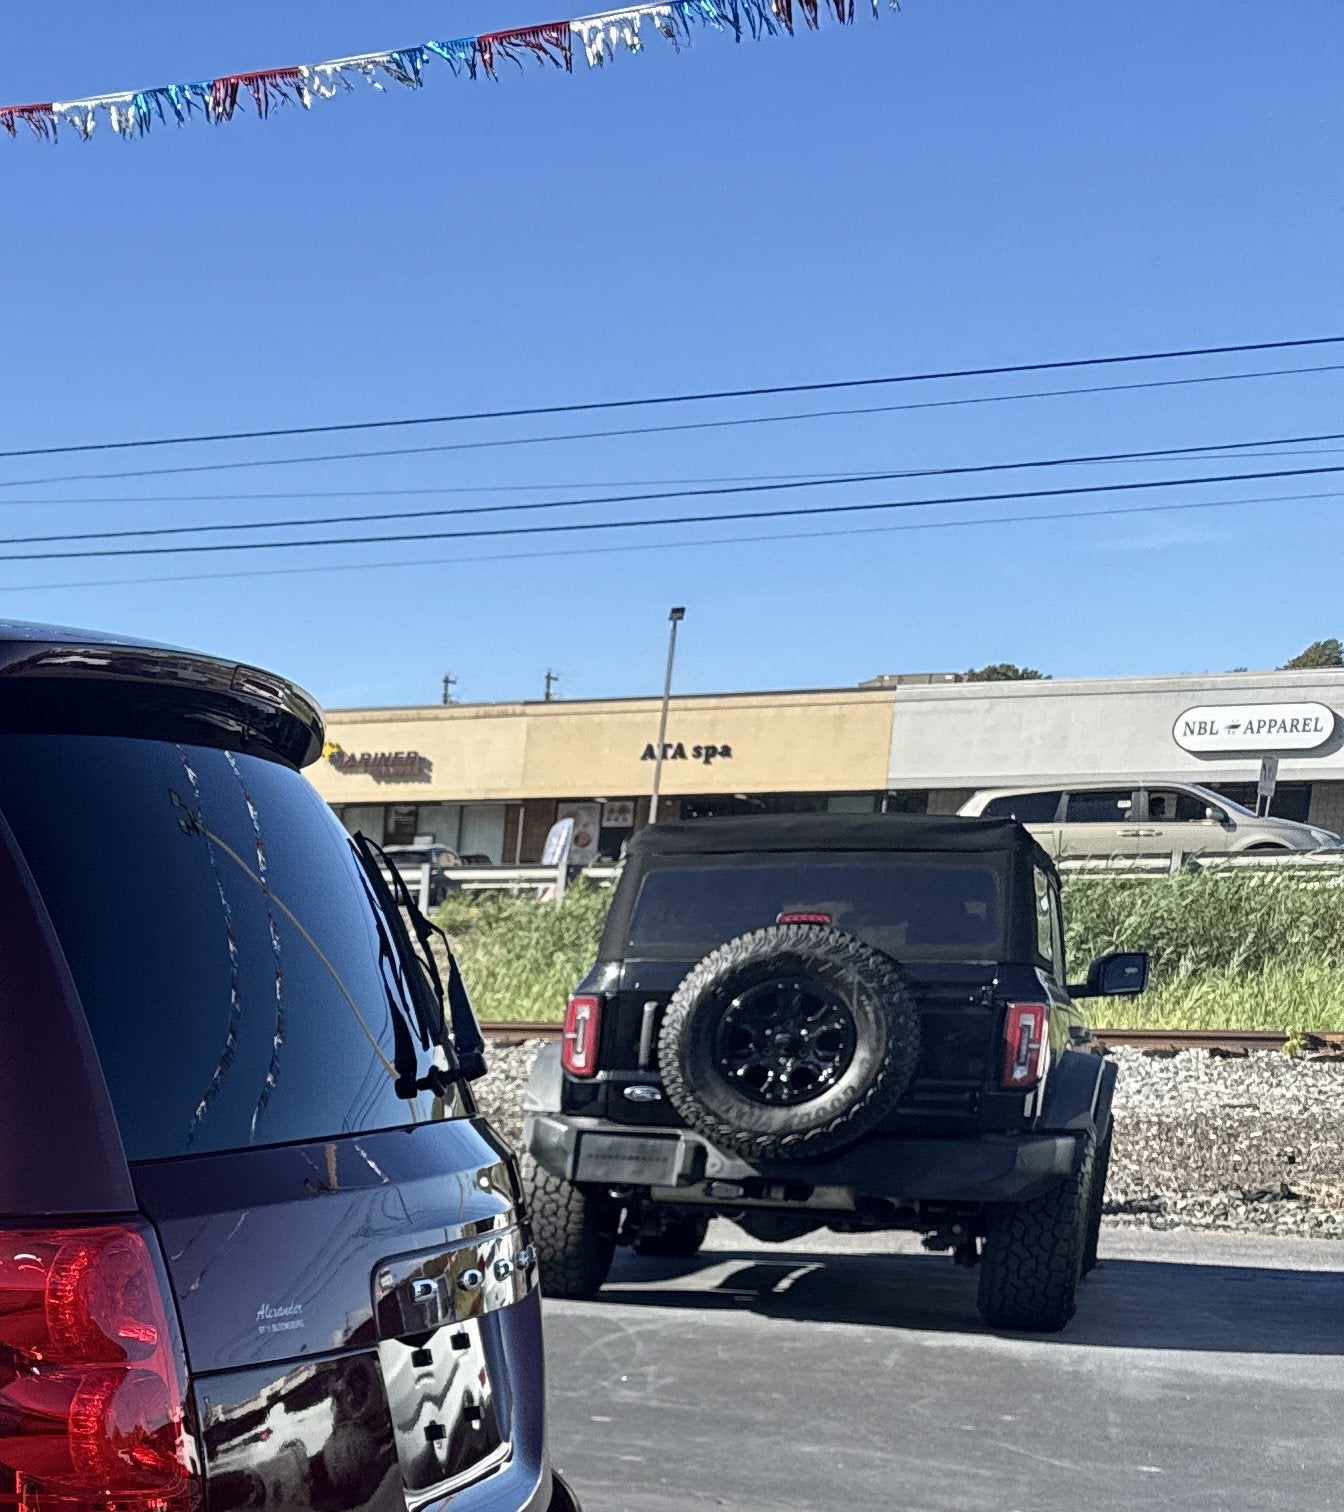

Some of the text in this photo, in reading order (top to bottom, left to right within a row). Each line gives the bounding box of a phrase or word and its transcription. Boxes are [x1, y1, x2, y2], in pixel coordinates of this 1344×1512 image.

[1182, 717, 1324, 737] NBL APPAREL
[691, 743, 733, 765] spa
[255, 1301, 304, 1322] Alexander
